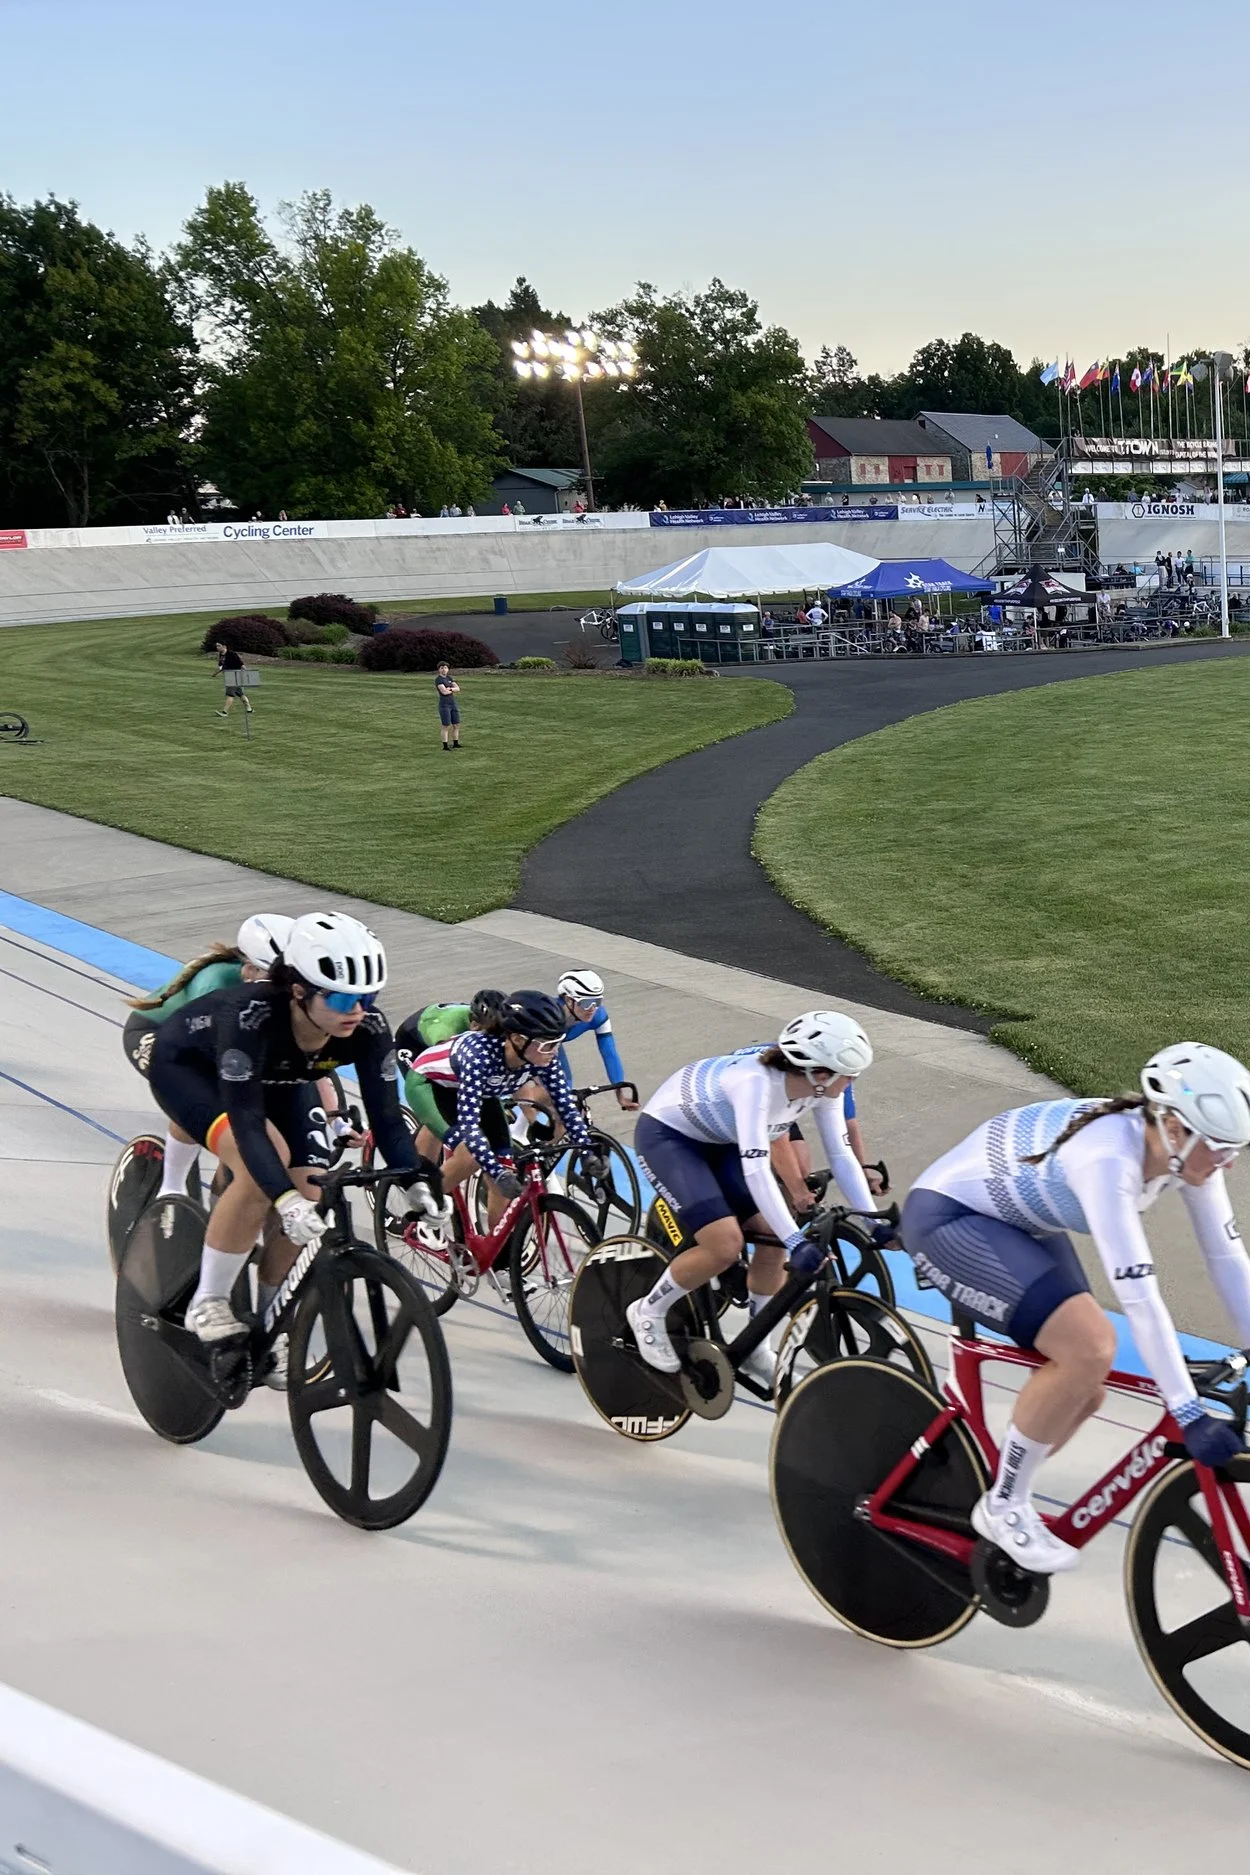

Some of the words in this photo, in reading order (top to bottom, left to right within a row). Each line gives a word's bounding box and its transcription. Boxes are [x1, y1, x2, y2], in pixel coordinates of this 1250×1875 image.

[1147, 504, 1194, 515] IGNOSH
[143, 526, 167, 535] Valley
[223, 525, 270, 539] Cycling
[273, 525, 314, 537] Center
[637, 1155, 657, 1183] STAR
[655, 1181, 682, 1213] TRACK
[658, 1203, 680, 1241] MAVIC
[914, 1252, 952, 1291] STAR
[951, 1281, 1010, 1322] TRACK
